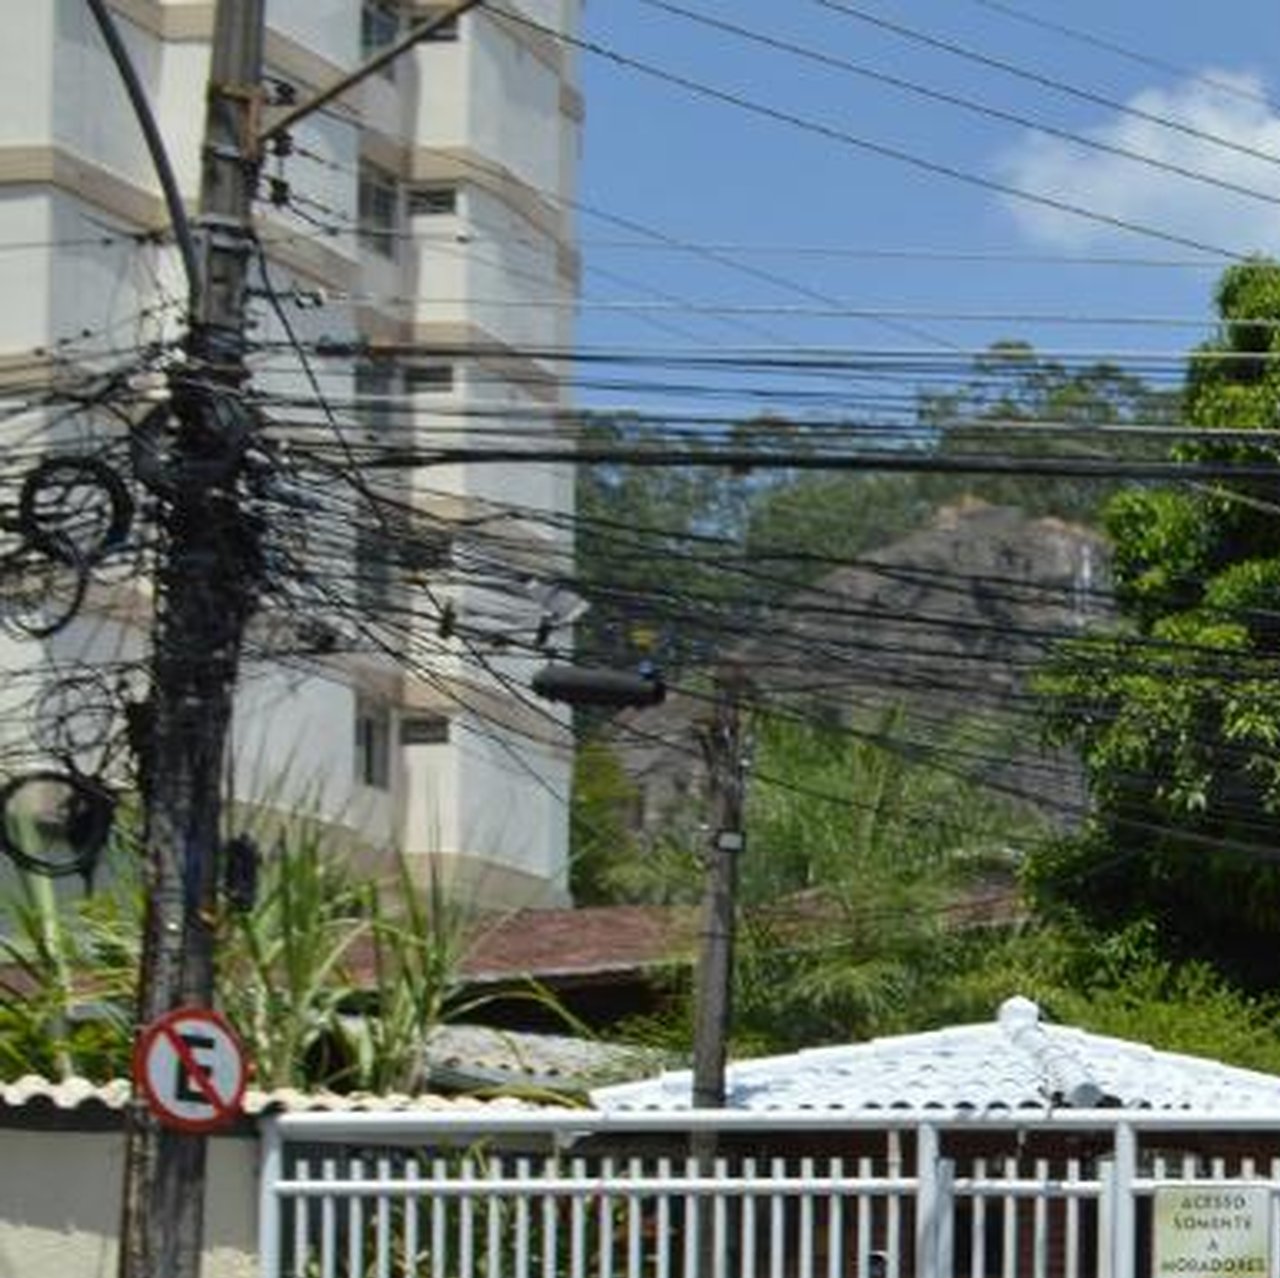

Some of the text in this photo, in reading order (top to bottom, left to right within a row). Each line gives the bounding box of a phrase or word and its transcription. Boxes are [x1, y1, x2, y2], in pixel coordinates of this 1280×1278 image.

[1181, 1194, 1246, 1210] ACESSO
[1172, 1215, 1252, 1230] SOMENTE
[1161, 1256, 1266, 1273] MORADORES
